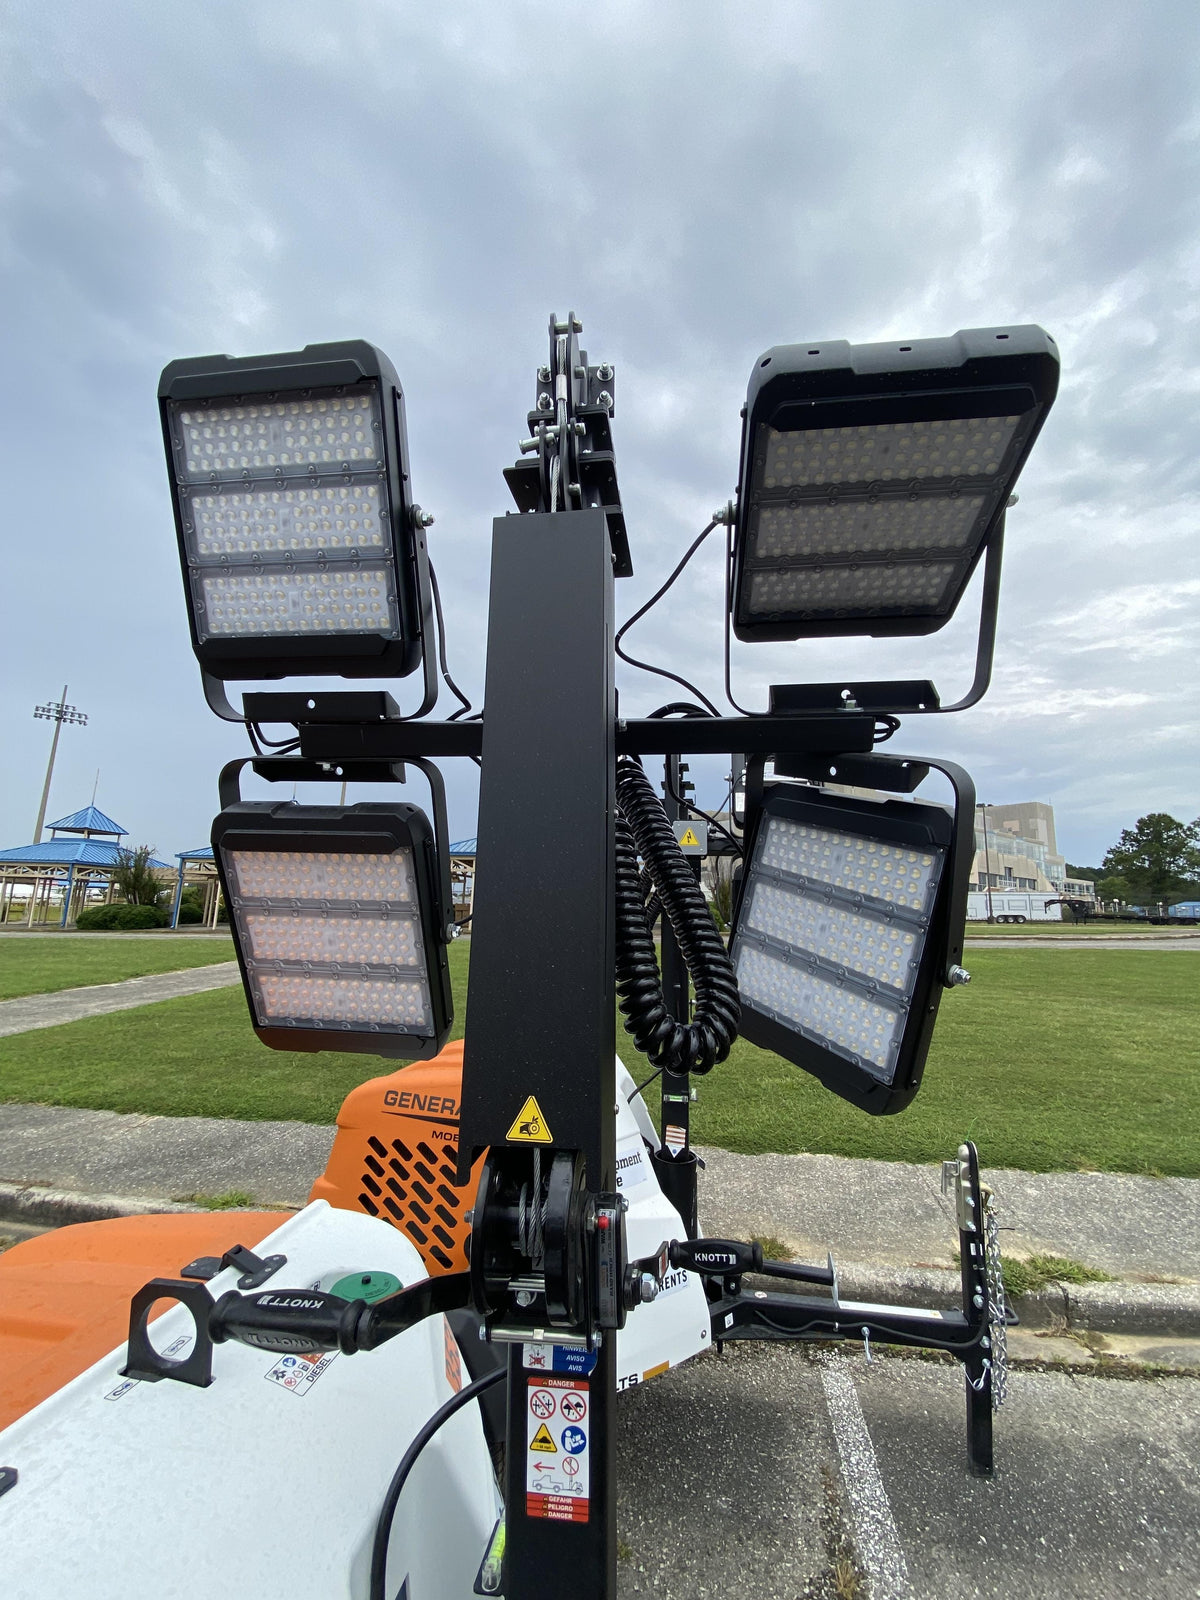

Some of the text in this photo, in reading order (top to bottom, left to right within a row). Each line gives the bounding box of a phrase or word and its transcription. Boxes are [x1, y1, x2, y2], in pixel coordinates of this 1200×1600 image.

[694, 1252, 729, 1263] KNOTT
[269, 1295, 324, 1309] KNOTT
[566, 1354, 585, 1362] AVISO
[305, 1358, 331, 1383] DIESEL
[568, 1364, 583, 1372] AVIS
[548, 1379, 575, 1388] DANGER
[548, 1496, 573, 1504] GEFAHR
[547, 1503, 574, 1512] PELIGRO
[548, 1511, 573, 1519] DANGER
